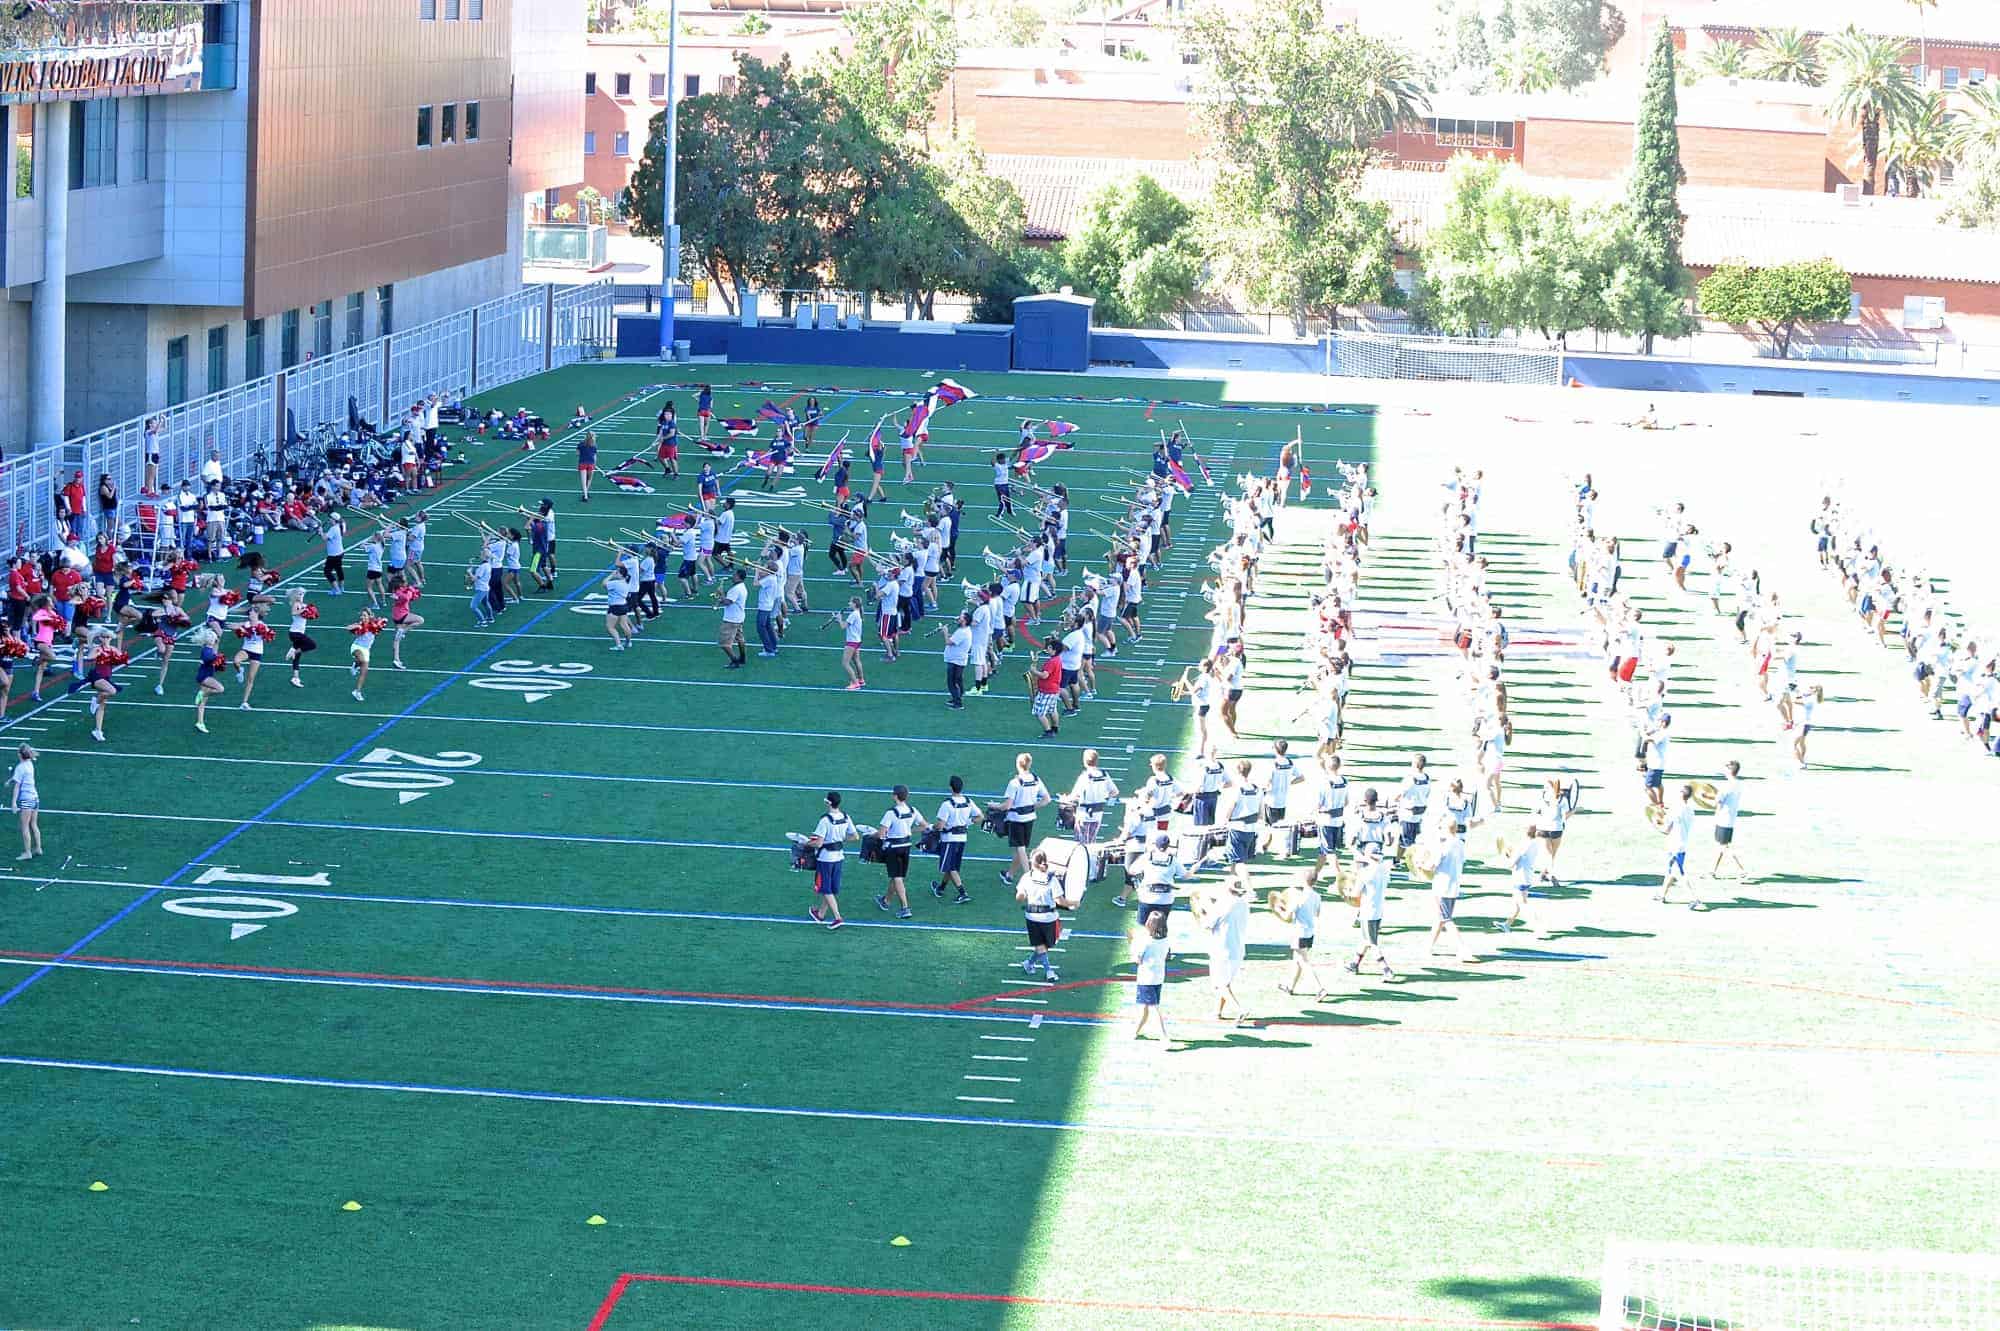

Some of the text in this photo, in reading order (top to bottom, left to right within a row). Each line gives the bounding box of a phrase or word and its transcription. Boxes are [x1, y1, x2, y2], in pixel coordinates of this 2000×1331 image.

[40, 57, 109, 90] FOOTBALL
[113, 55, 170, 86] FACILITY
[468, 660, 593, 690] 30
[335, 748, 482, 789] 20
[162, 867, 332, 919] 10
